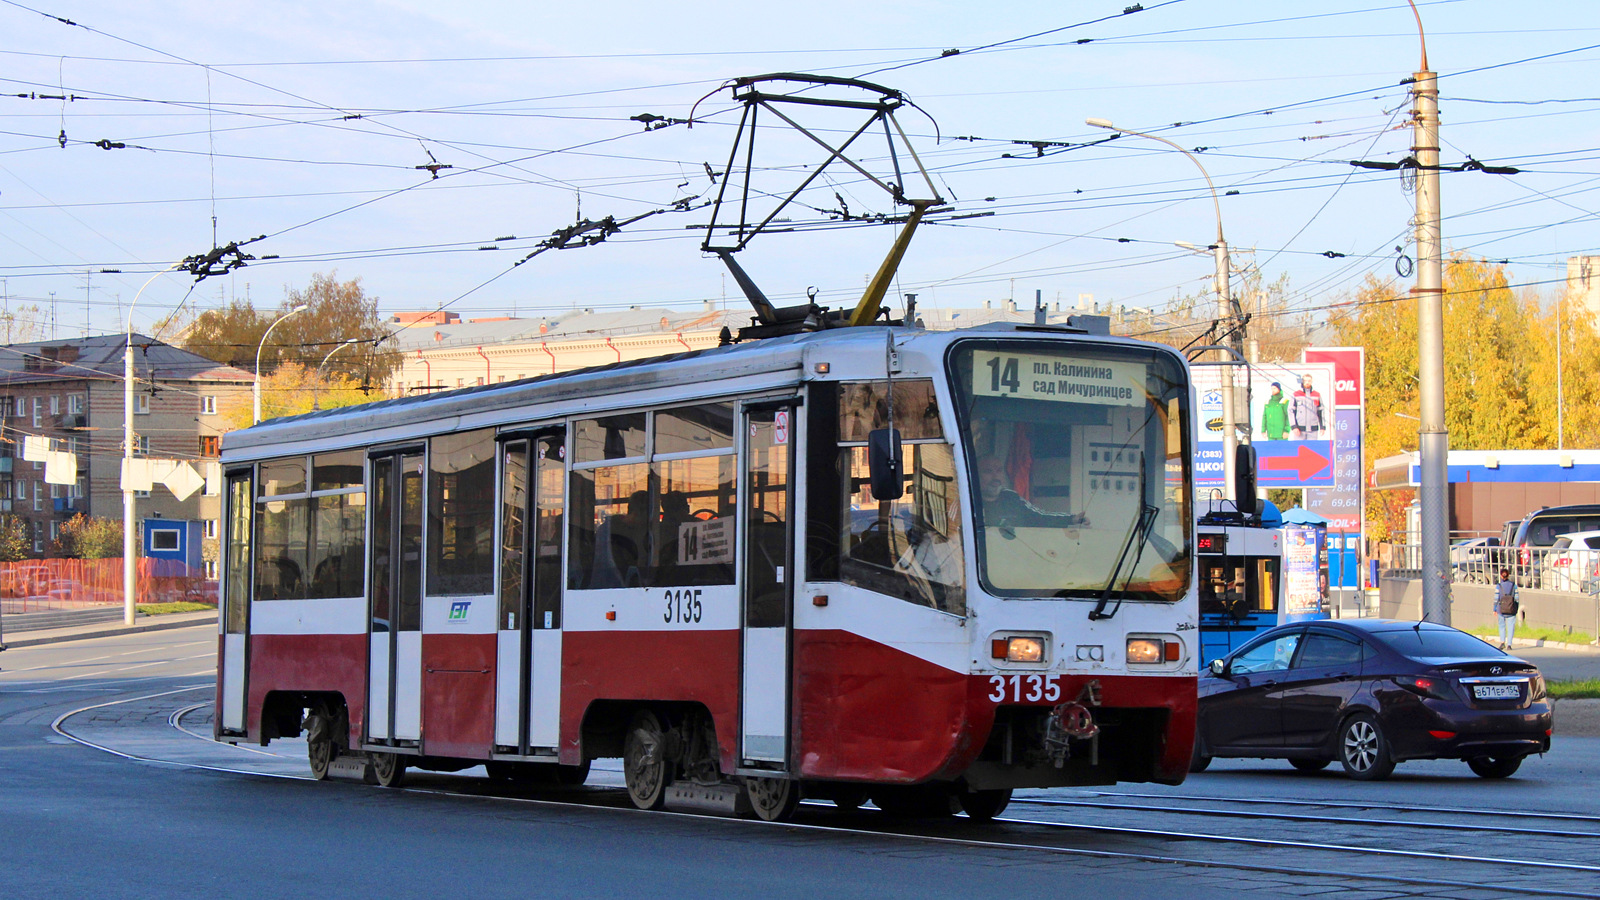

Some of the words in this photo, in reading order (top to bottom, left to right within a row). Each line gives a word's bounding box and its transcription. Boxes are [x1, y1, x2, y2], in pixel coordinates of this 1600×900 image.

[986, 356, 1020, 393] 14
[1033, 362, 1051, 375] пл.
[1054, 362, 1112, 380] Калинина
[1033, 380, 1055, 395] сад
[1058, 380, 1133, 400] Мичуринцев
[1202, 450, 1222, 459] (383)
[682, 526, 698, 562] 14
[1198, 538, 1212, 548] 24
[663, 589, 702, 624] 3135
[988, 674, 1061, 703] 3135
